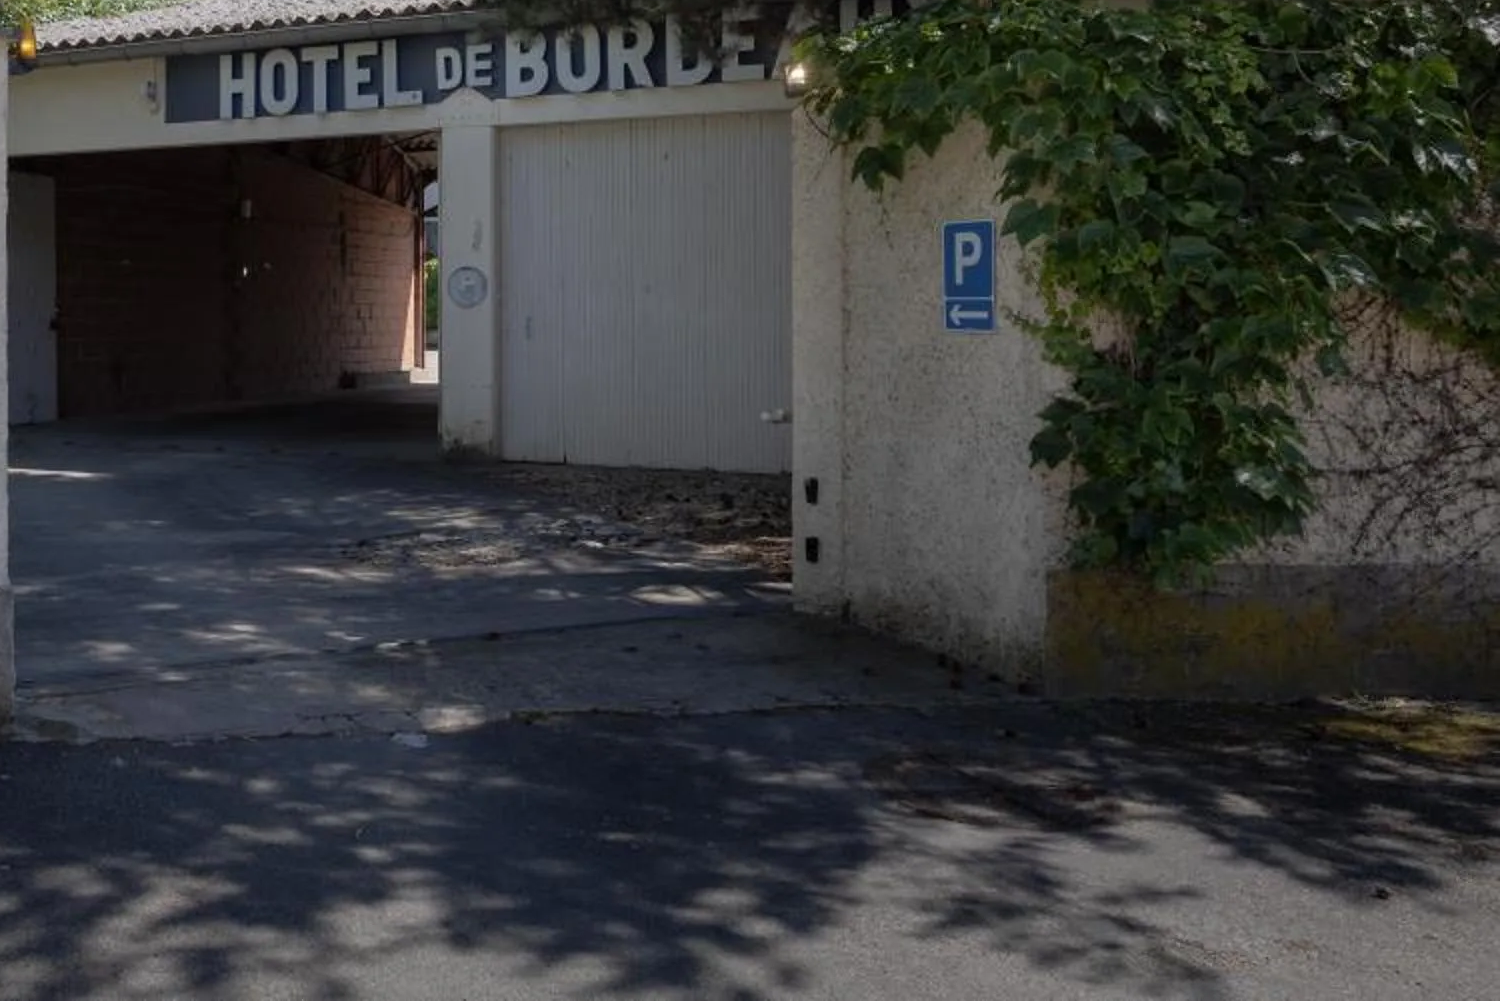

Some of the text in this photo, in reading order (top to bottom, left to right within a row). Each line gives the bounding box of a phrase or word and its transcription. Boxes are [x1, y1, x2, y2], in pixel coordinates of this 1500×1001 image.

[219, 38, 423, 120] HOTEL
[435, 43, 494, 91] DE
[954, 231, 983, 286] P
